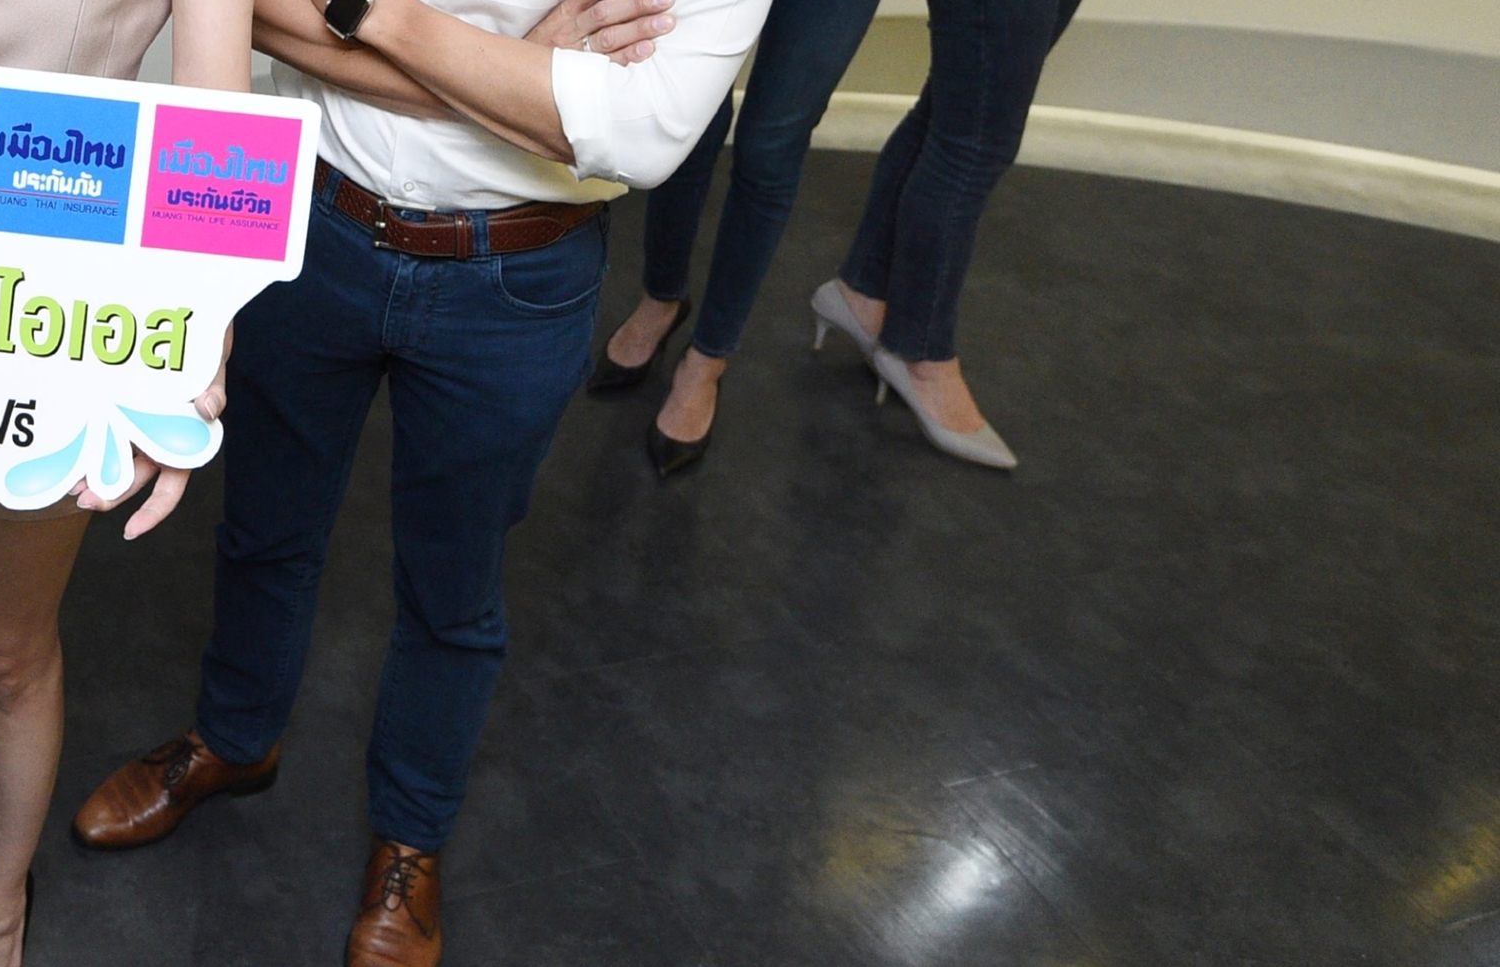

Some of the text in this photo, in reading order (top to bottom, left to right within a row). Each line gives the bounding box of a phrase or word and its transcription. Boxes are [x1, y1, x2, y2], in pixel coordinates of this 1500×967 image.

[158, 139, 289, 186] เมืองไทย
[12, 168, 103, 198] ประกันภัย
[35, 198, 57, 210] THAI
[63, 202, 119, 217] INSURANCE
[167, 186, 272, 215] ประกันชีวิต
[152, 210, 280, 231] MUANG THAI LIFE ASSURANCE
